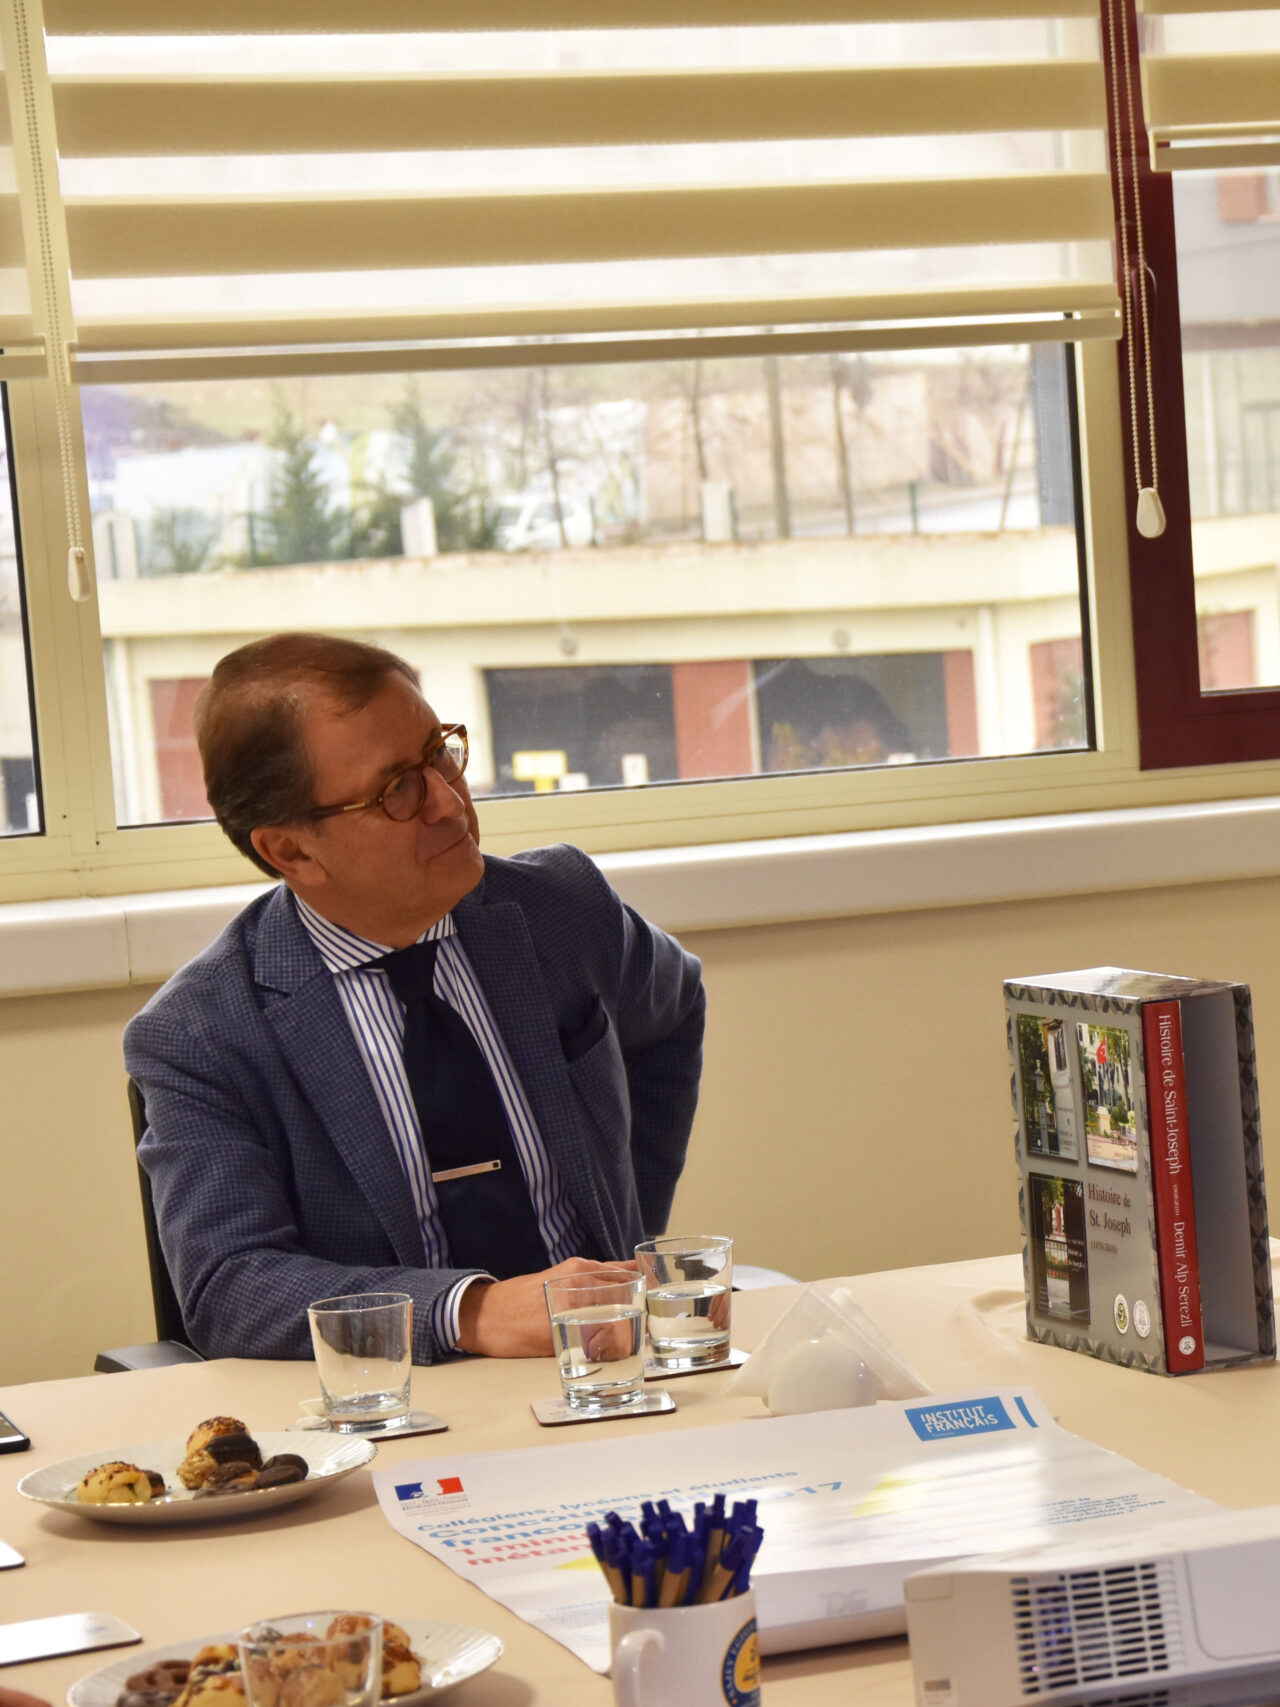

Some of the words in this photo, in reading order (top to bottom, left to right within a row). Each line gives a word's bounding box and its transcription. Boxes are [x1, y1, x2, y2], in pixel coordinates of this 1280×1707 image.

[1158, 1014, 1172, 1067] Histoire
[1163, 1070, 1177, 1088] de
[1163, 1090, 1184, 1175] Saint-Joseph
[1088, 1182, 1121, 1206] Histoire
[1123, 1191, 1131, 1208] de
[1089, 1209, 1101, 1227] St.
[1103, 1211, 1131, 1238] Joseph
[1173, 1221, 1187, 1259] Demir
[1175, 1261, 1191, 1284] Alp
[1178, 1286, 1193, 1328] Serezli
[920, 1405, 985, 1425] INSTITUT
[560, 1493, 653, 1510] lycéens
[660, 1487, 681, 1496] et
[689, 1471, 799, 1490] étudiants
